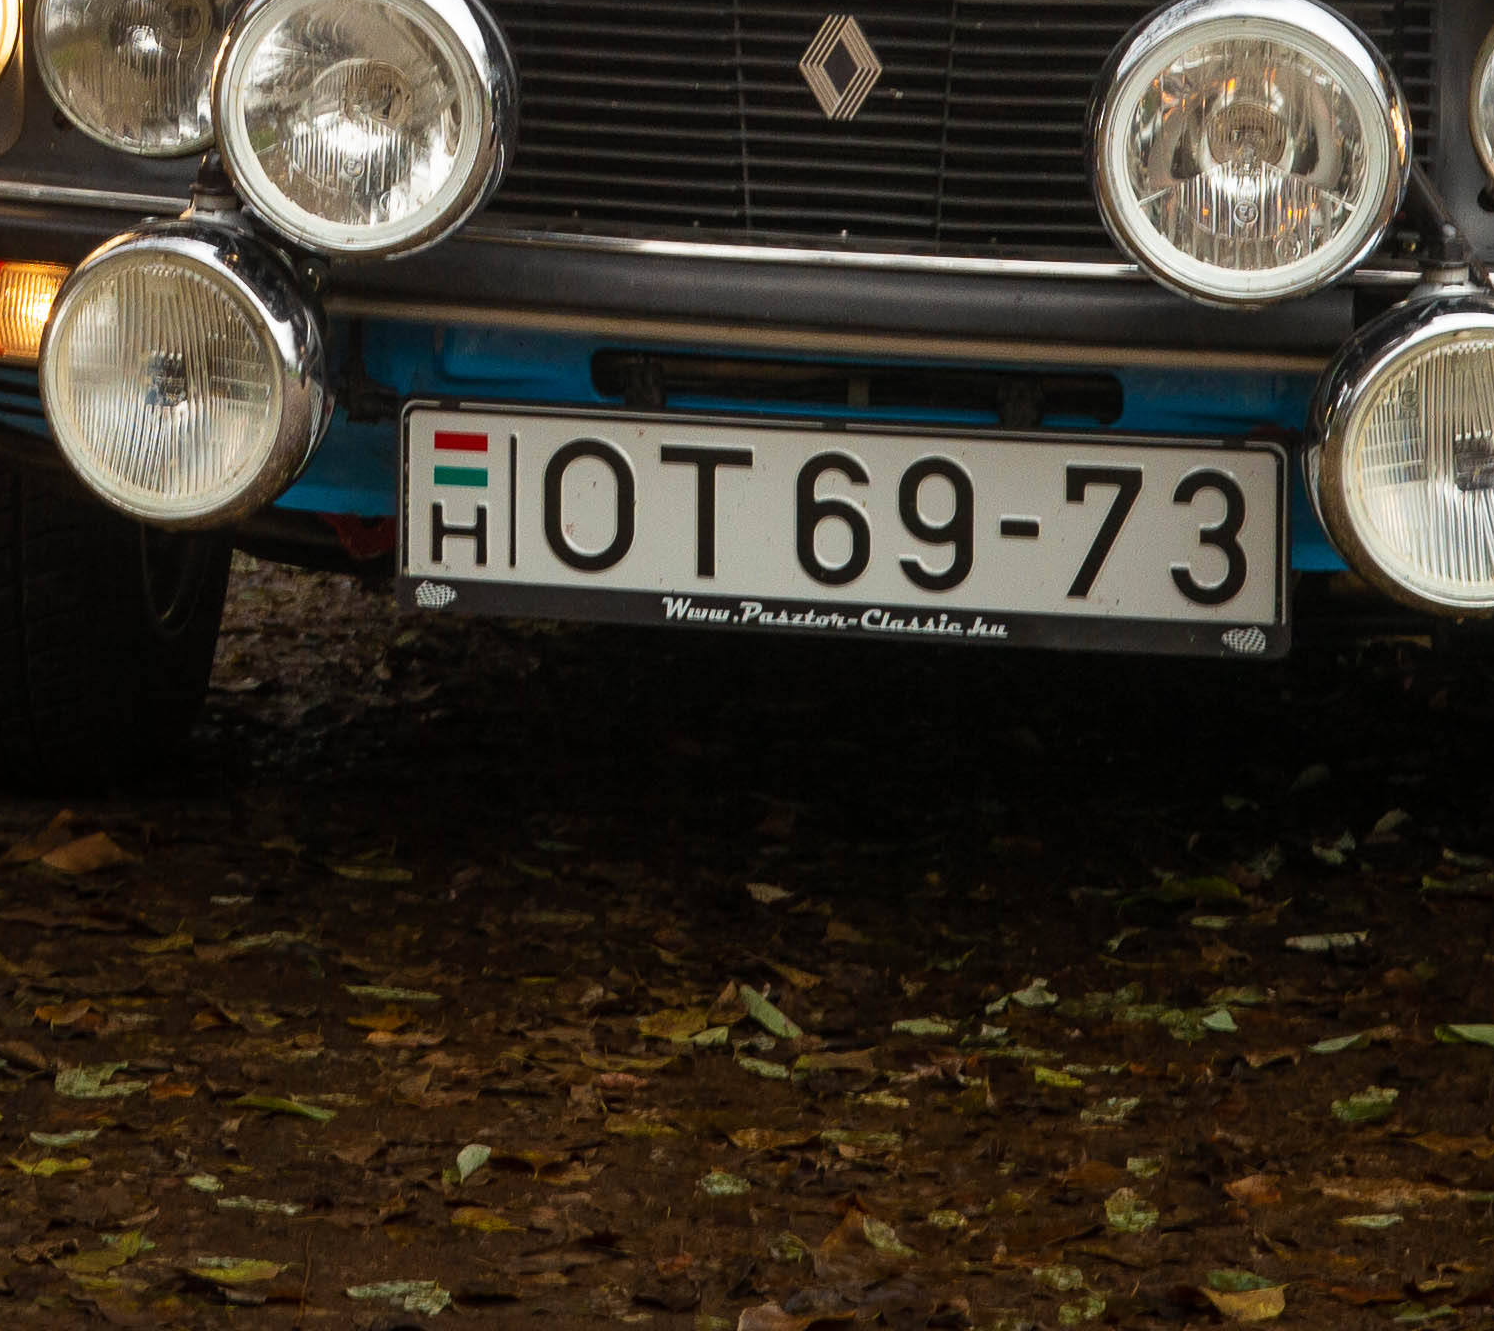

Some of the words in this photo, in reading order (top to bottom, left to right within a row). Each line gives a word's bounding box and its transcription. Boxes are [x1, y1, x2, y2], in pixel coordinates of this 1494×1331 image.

[430, 501, 488, 567] H
[542, 437, 754, 578] OT
[795, 450, 1248, 607] 69-73
[661, 596, 1009, 640] Www.Pasztor-Classic.hu
